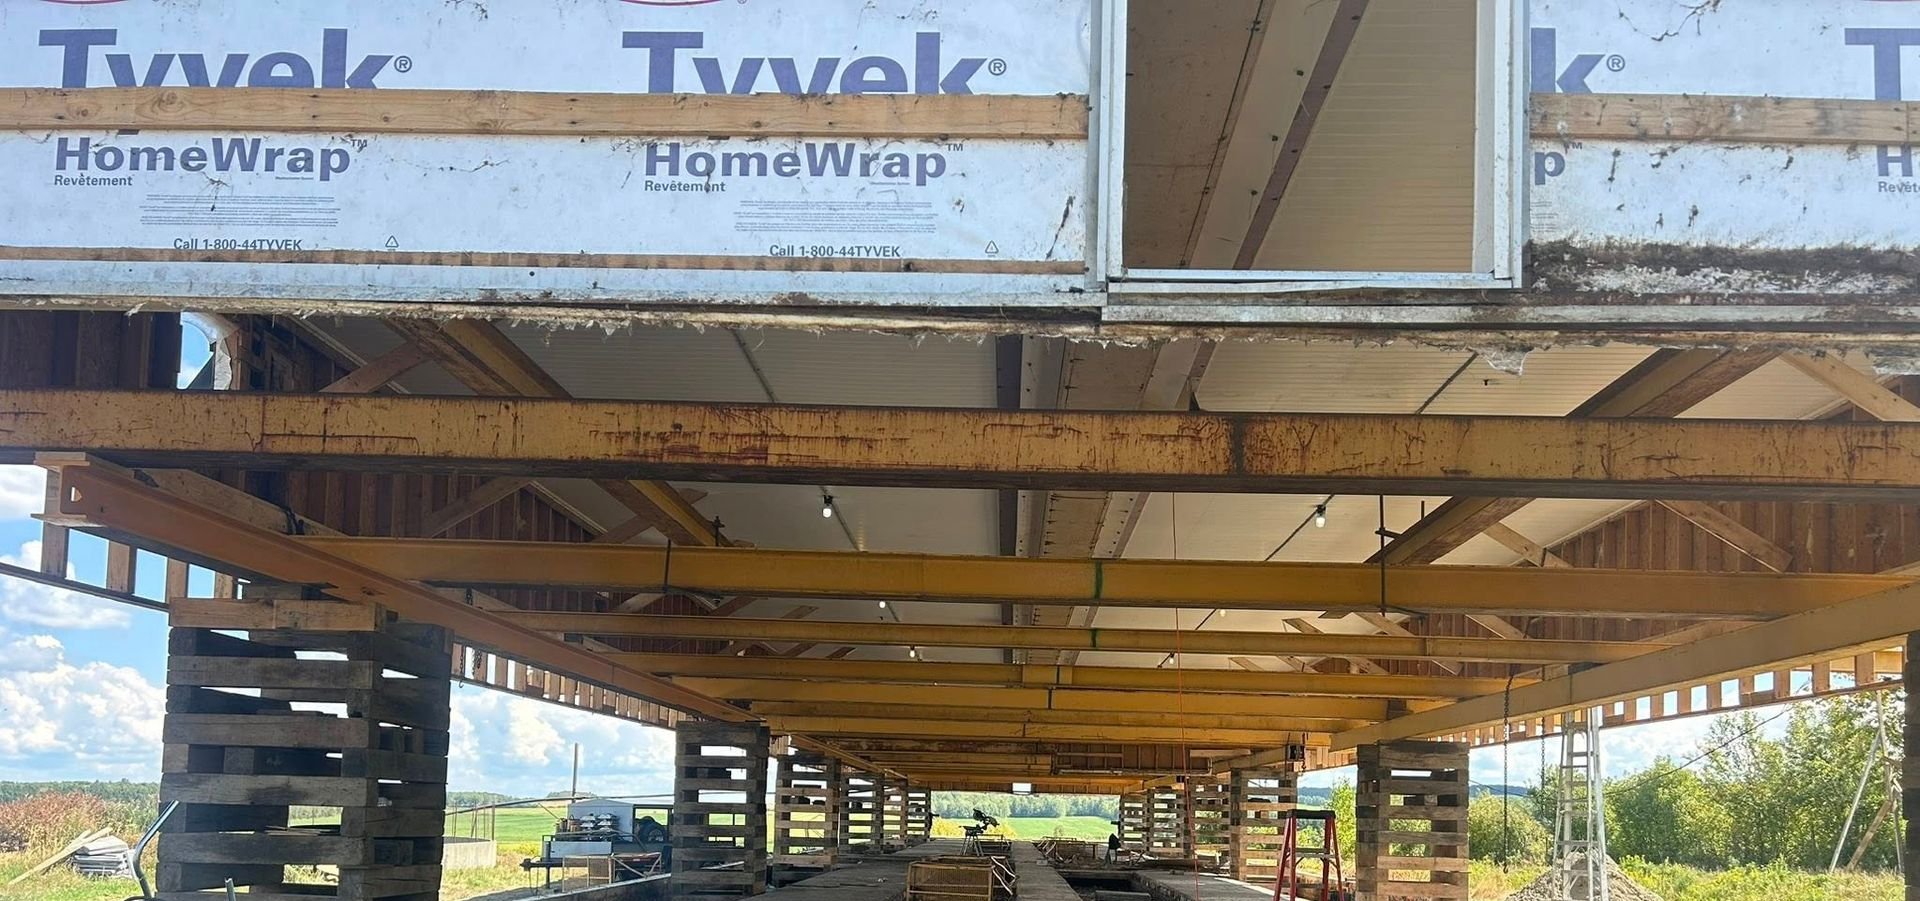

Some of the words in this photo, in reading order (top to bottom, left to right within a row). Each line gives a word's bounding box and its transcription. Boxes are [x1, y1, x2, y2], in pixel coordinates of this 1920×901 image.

[173, 238, 198, 250] Call
[202, 238, 302, 251] 1-800-44TYVEK
[769, 244, 795, 257] Call
[799, 245, 901, 258] 1-800-44TYVEK
